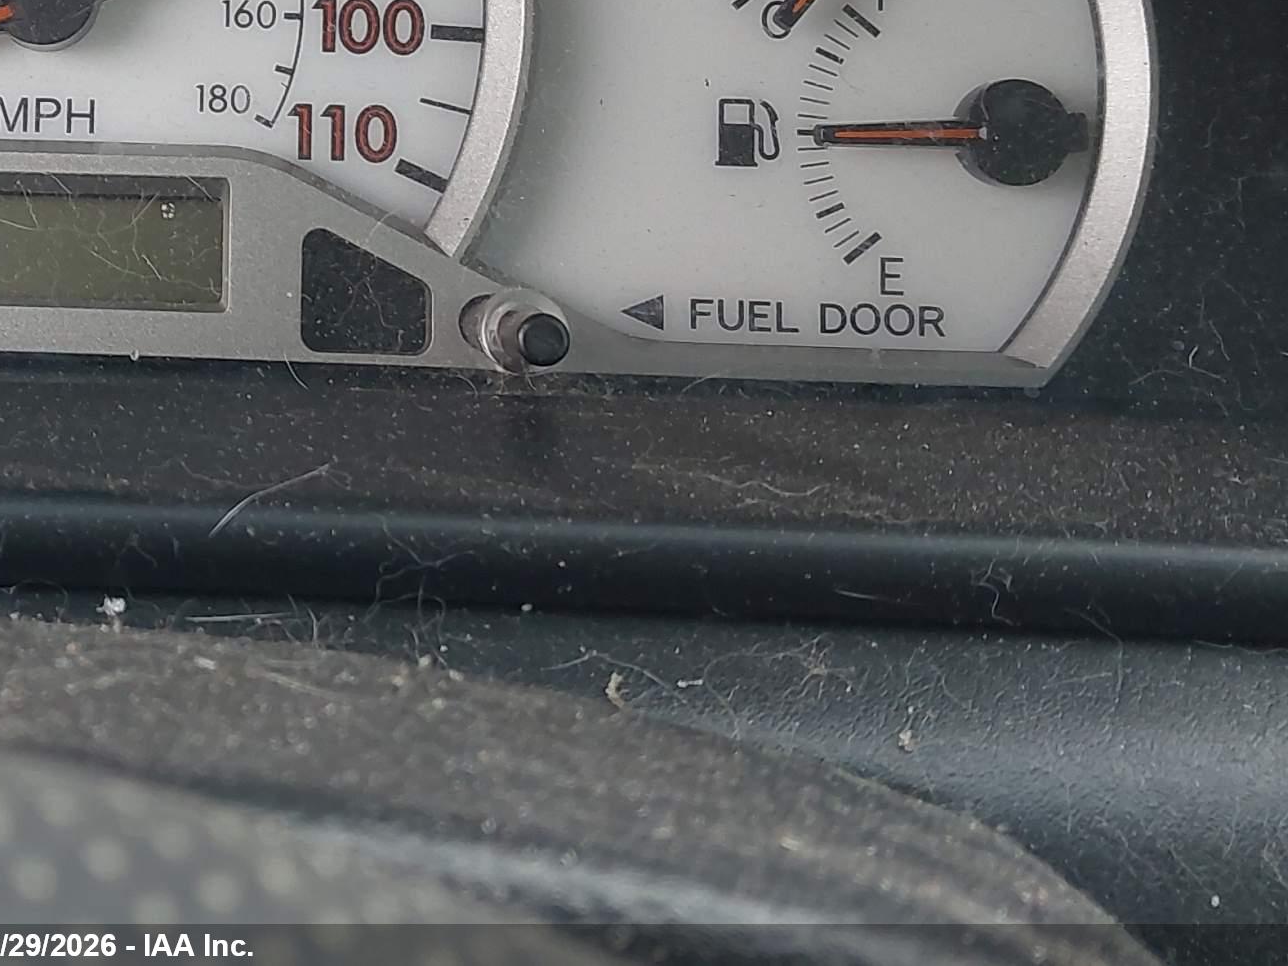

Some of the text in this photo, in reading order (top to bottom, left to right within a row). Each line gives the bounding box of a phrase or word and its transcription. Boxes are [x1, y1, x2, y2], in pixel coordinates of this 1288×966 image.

[222, 0, 276, 29] 160
[196, 84, 250, 114] 180
[288, 104, 397, 162] 110
[880, 257, 904, 296] E
[691, 299, 946, 337] FUEL DOOR
